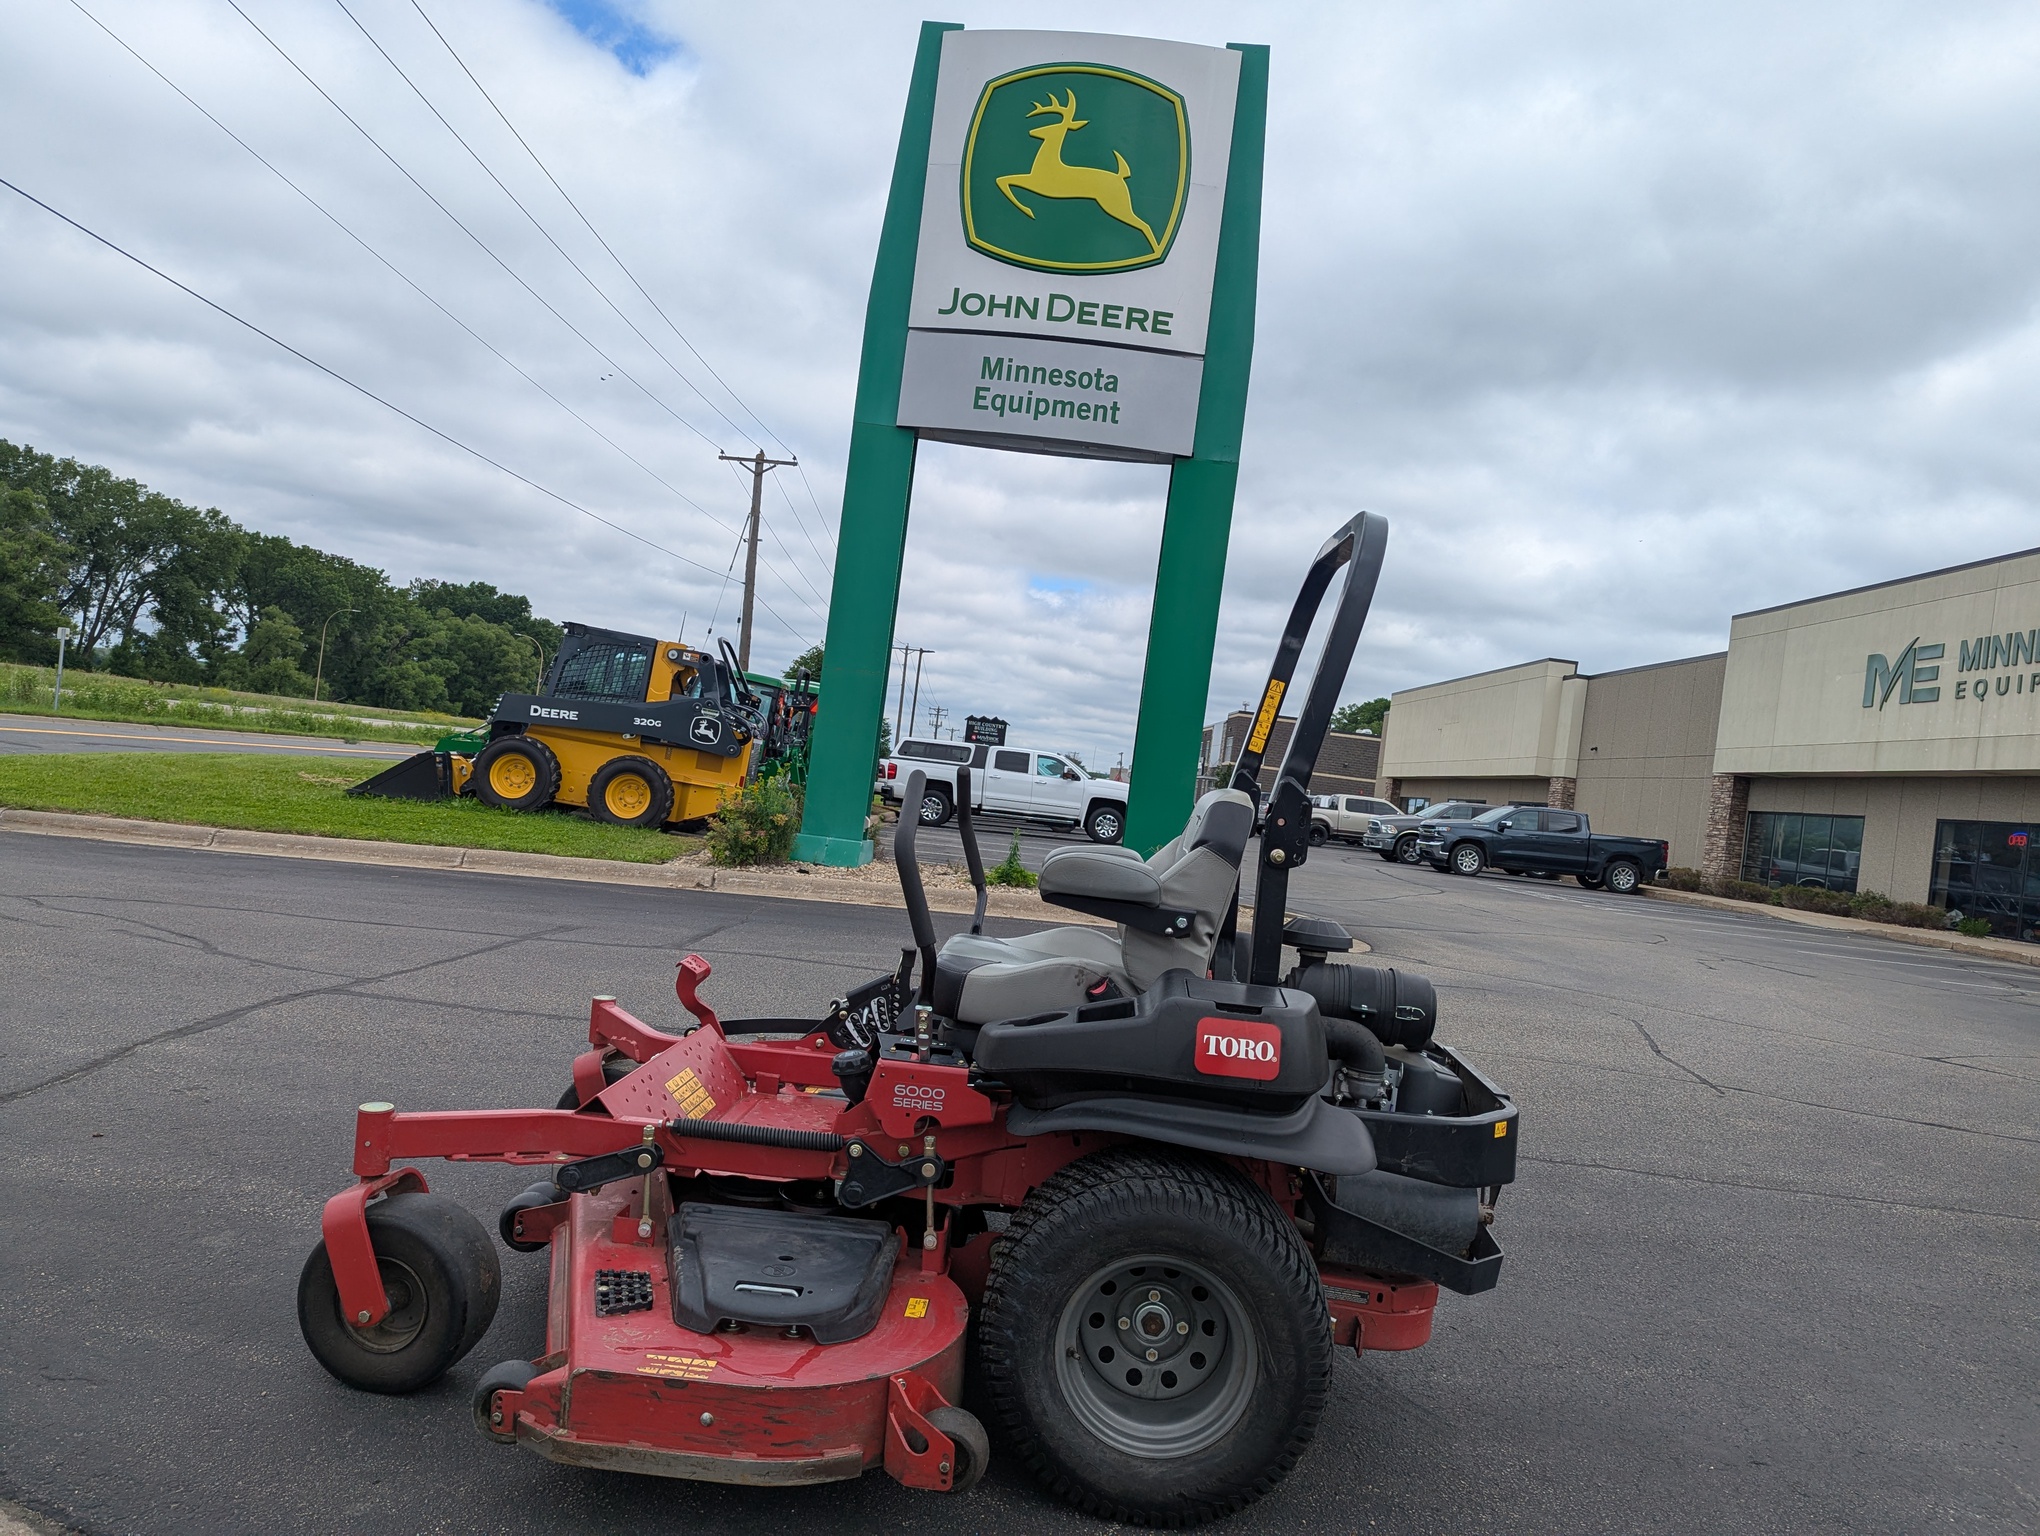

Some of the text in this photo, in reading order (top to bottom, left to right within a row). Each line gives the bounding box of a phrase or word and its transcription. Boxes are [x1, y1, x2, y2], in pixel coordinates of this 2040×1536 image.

[937, 287, 1174, 336] JOHN DEERE
[980, 356, 1119, 393] Minnesota
[972, 386, 1121, 425] Equipment
[529, 704, 579, 721] DEERE
[633, 717, 662, 728] 320G
[982, 722, 1005, 730] COUNTRY
[894, 1084, 946, 1100] 6000
[892, 1097, 944, 1112] SERIES
